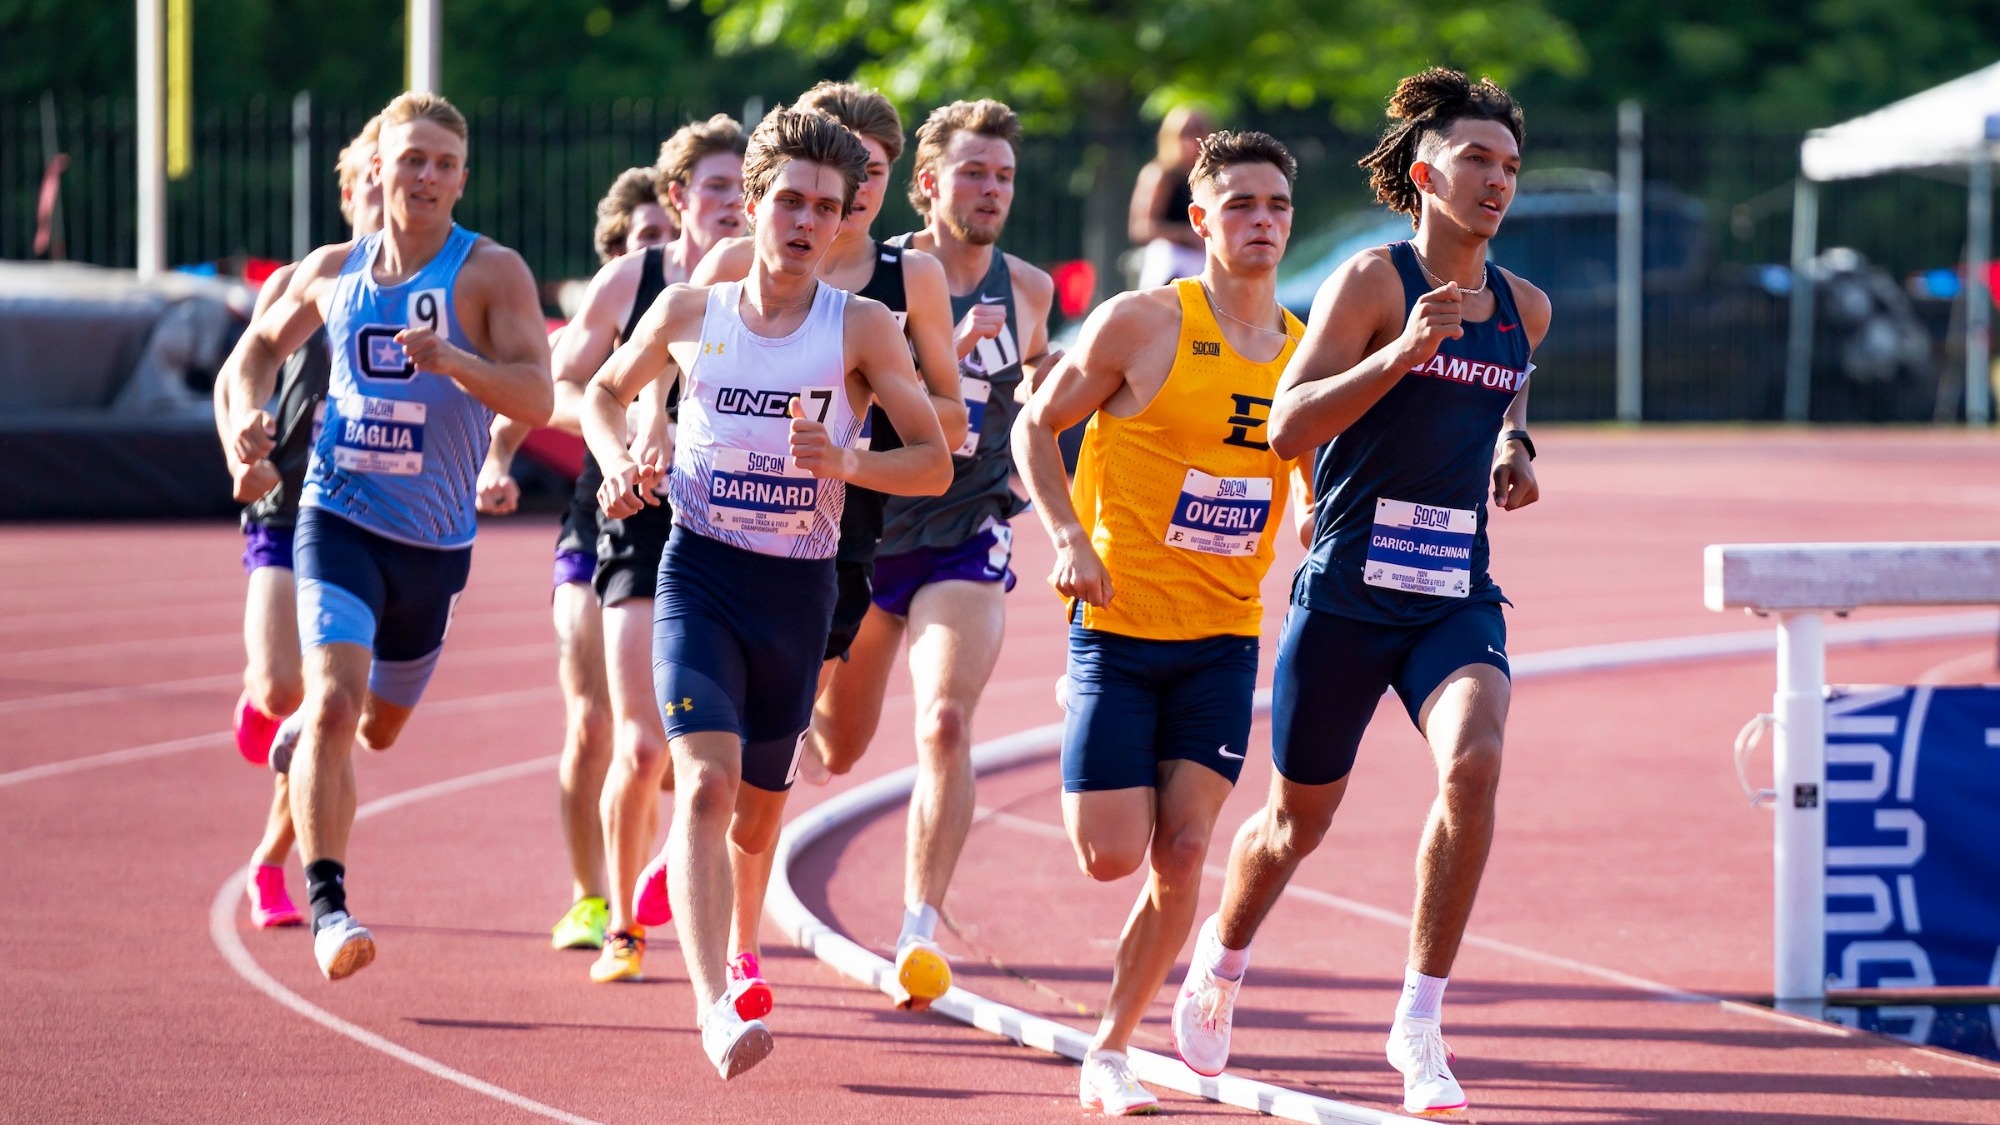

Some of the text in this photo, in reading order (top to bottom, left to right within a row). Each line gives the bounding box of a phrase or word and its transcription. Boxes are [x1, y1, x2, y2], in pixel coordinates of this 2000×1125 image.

[416, 292, 438, 332] 9
[716, 387, 800, 418] UNC
[810, 390, 833, 424] 7
[344, 420, 414, 450] BAGLIA
[1222, 393, 1273, 452] E
[712, 476, 814, 507] BARNARD
[731, 516, 754, 525] OUTDOOR
[755, 519, 771, 527] TRACK
[775, 520, 789, 528] FIELD
[740, 524, 779, 534] CHAMPIONSHIPS
[1185, 501, 1262, 529] OVERLY
[1190, 536, 1212, 546] OUTDOOR
[1212, 540, 1226, 549] TRACK
[1372, 535, 1470, 560] CARICO-MCLENNAN
[1391, 573, 1416, 583] OUTDOOR
[1416, 577, 1431, 585] TRACK
[1433, 579, 1446, 587] FIELD
[1400, 582, 1437, 593] CHAMPIONSHIPS
